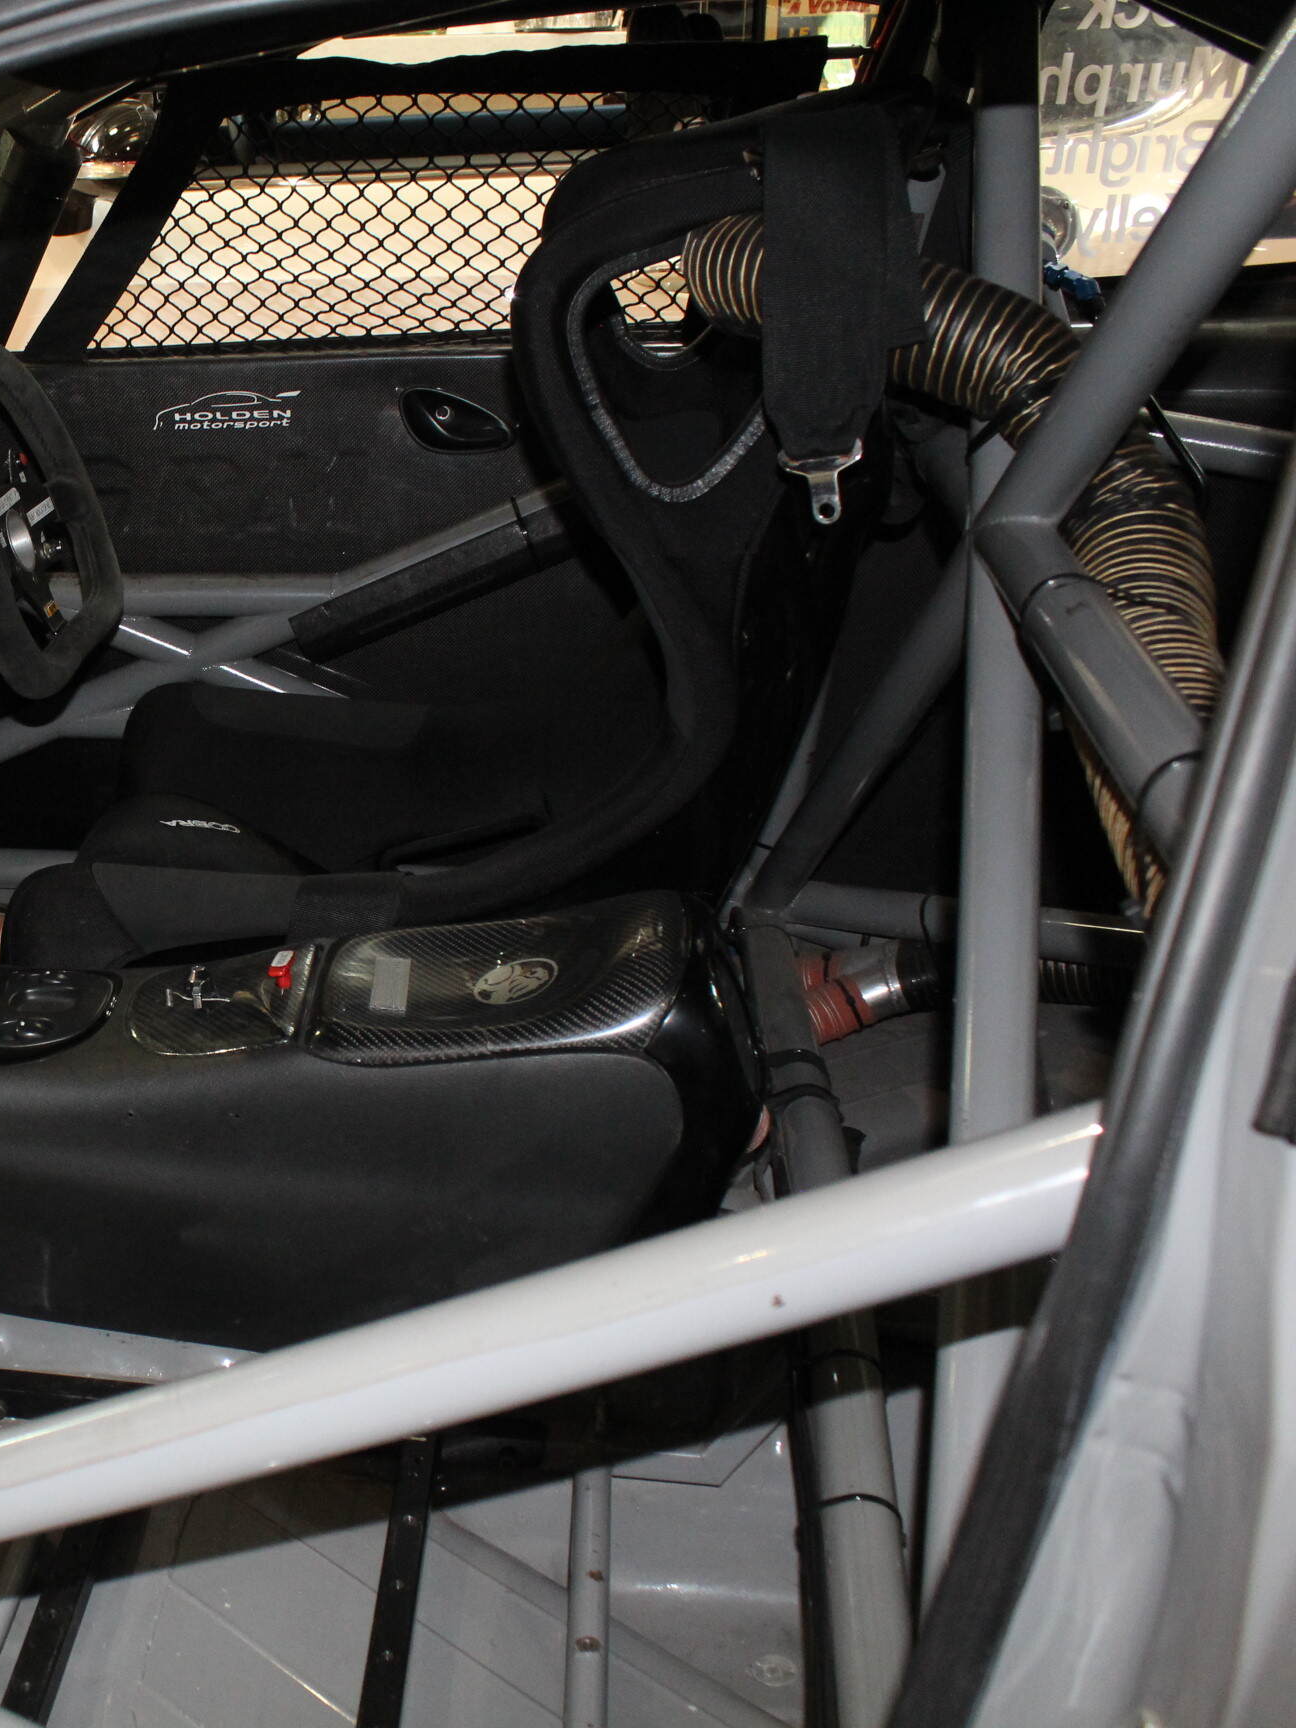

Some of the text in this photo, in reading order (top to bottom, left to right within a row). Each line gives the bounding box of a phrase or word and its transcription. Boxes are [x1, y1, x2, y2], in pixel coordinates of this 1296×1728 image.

[174, 409, 292, 421] HOLDEN
[174, 418, 291, 431] motorsport
[159, 819, 241, 833] COBRA
